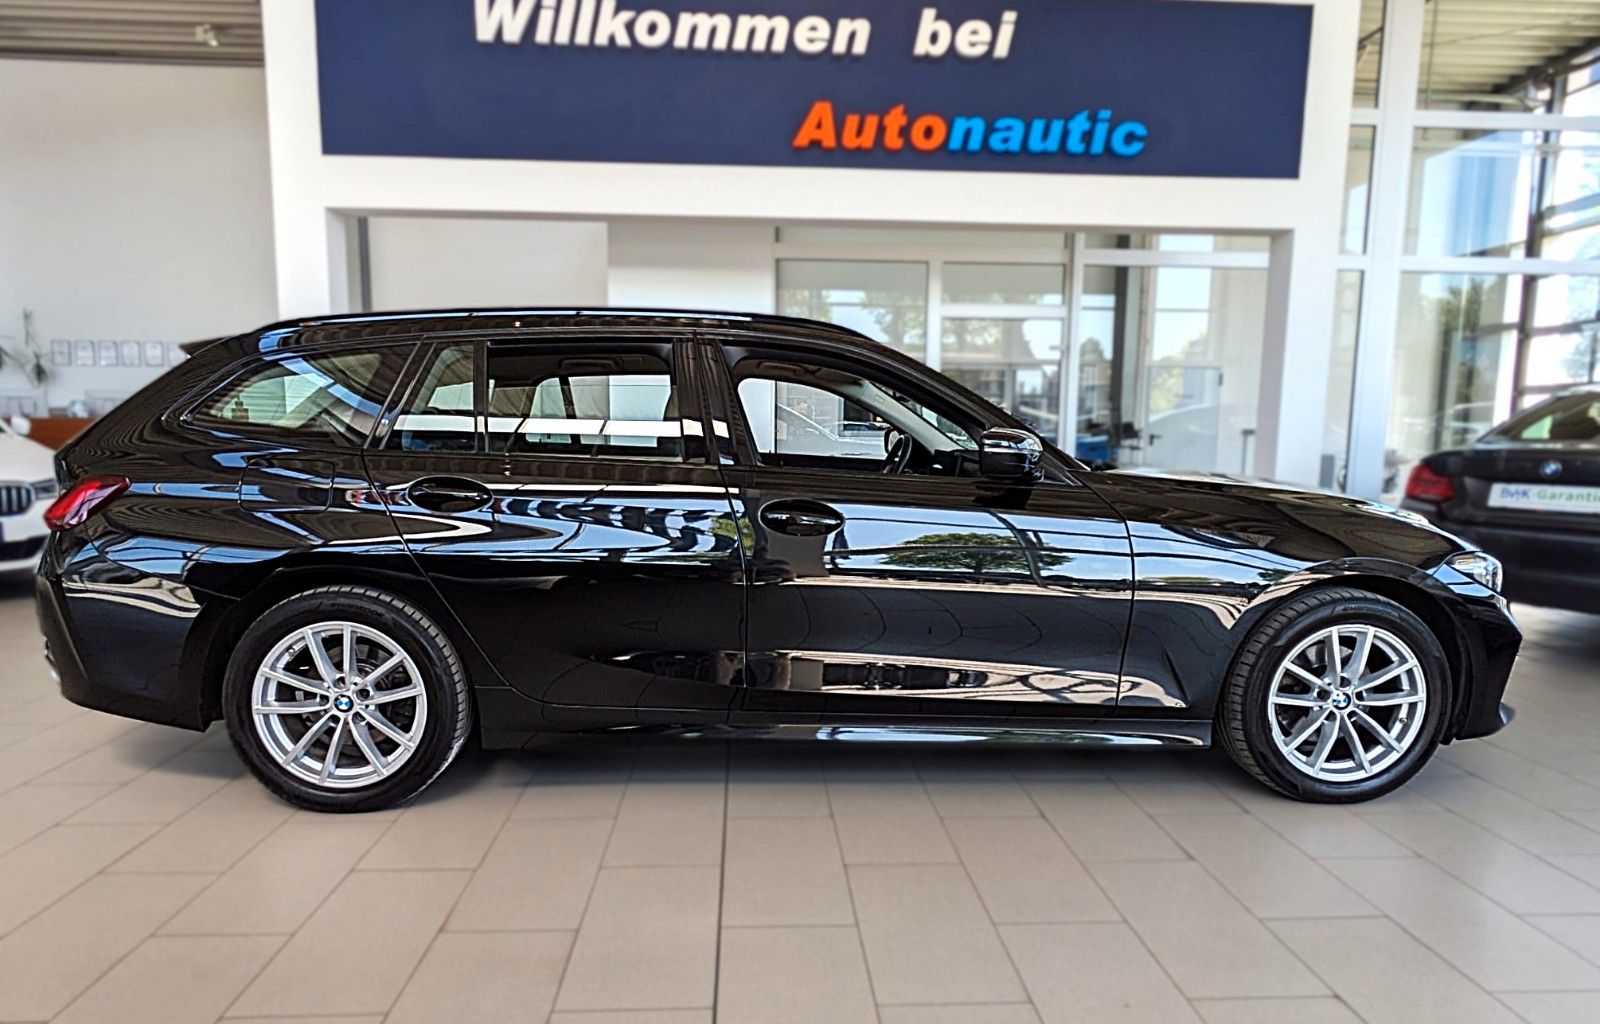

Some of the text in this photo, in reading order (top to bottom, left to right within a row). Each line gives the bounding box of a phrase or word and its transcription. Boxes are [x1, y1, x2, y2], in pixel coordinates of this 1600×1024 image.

[474, 0, 1018, 58] Willkommen bei
[792, 100, 1147, 156] Autonautic
[1536, 488, 1600, 503] Garanti
